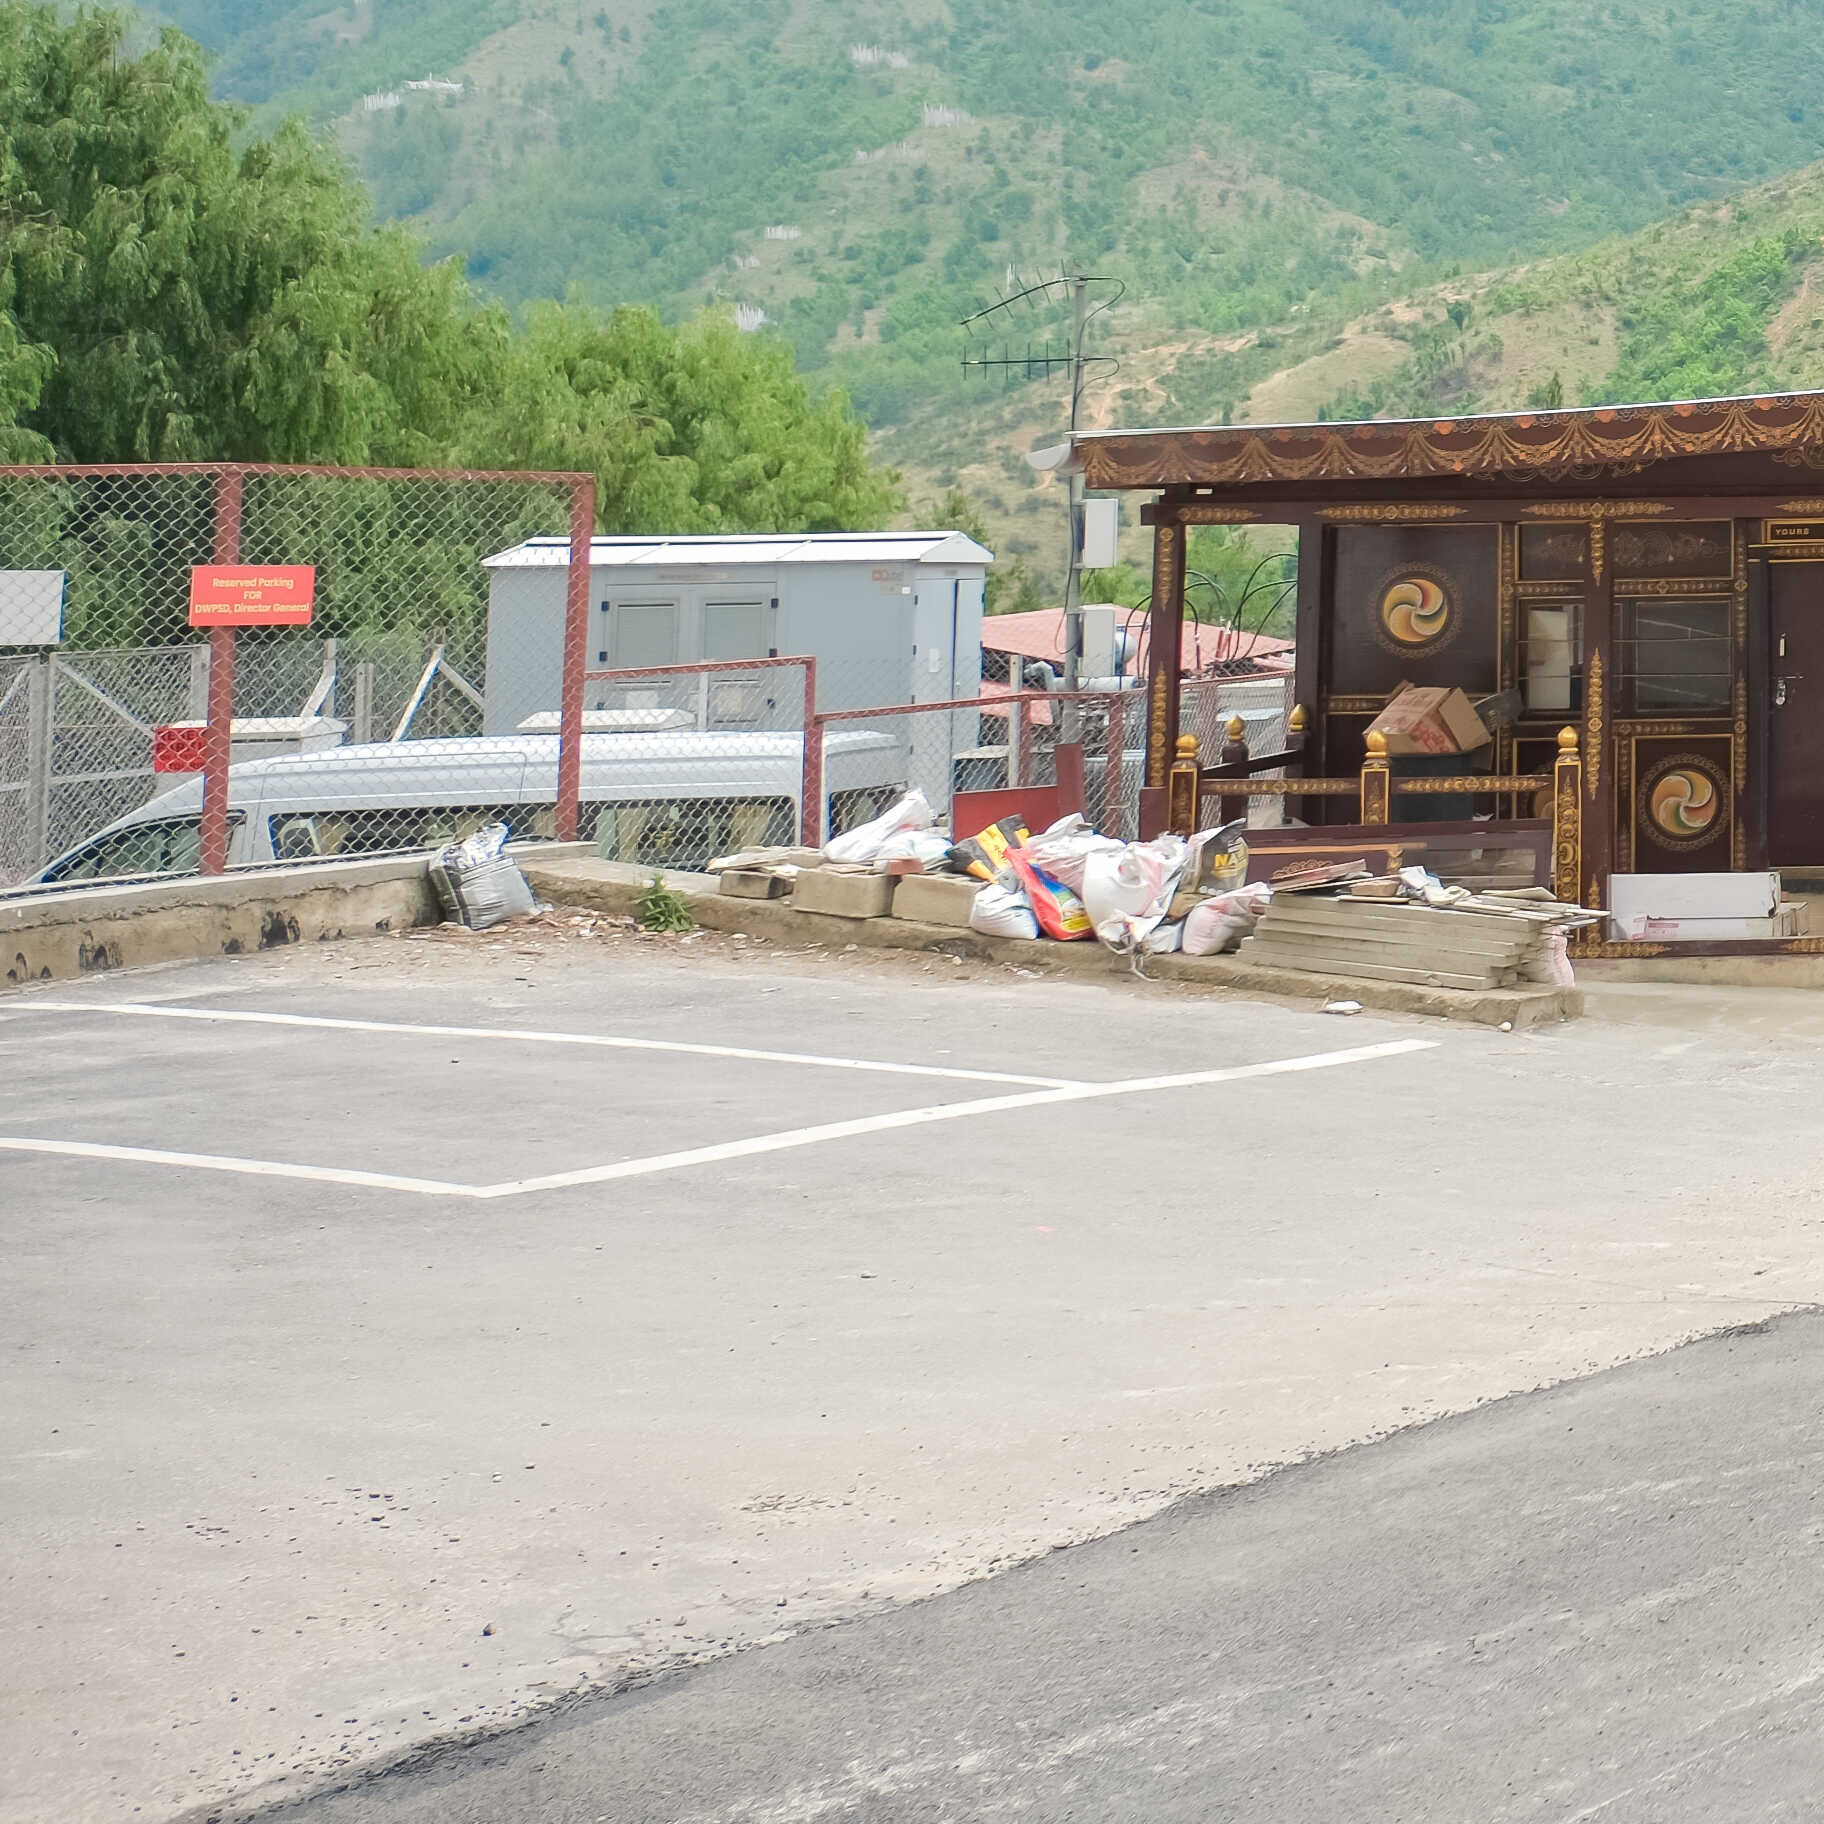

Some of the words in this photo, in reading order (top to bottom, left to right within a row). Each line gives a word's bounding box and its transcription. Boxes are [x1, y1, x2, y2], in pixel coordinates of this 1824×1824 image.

[213, 578, 257, 588] Reserved
[258, 577, 294, 590] Parking
[243, 591, 262, 600] FOR
[234, 603, 271, 613] Director
[272, 602, 310, 613] General
